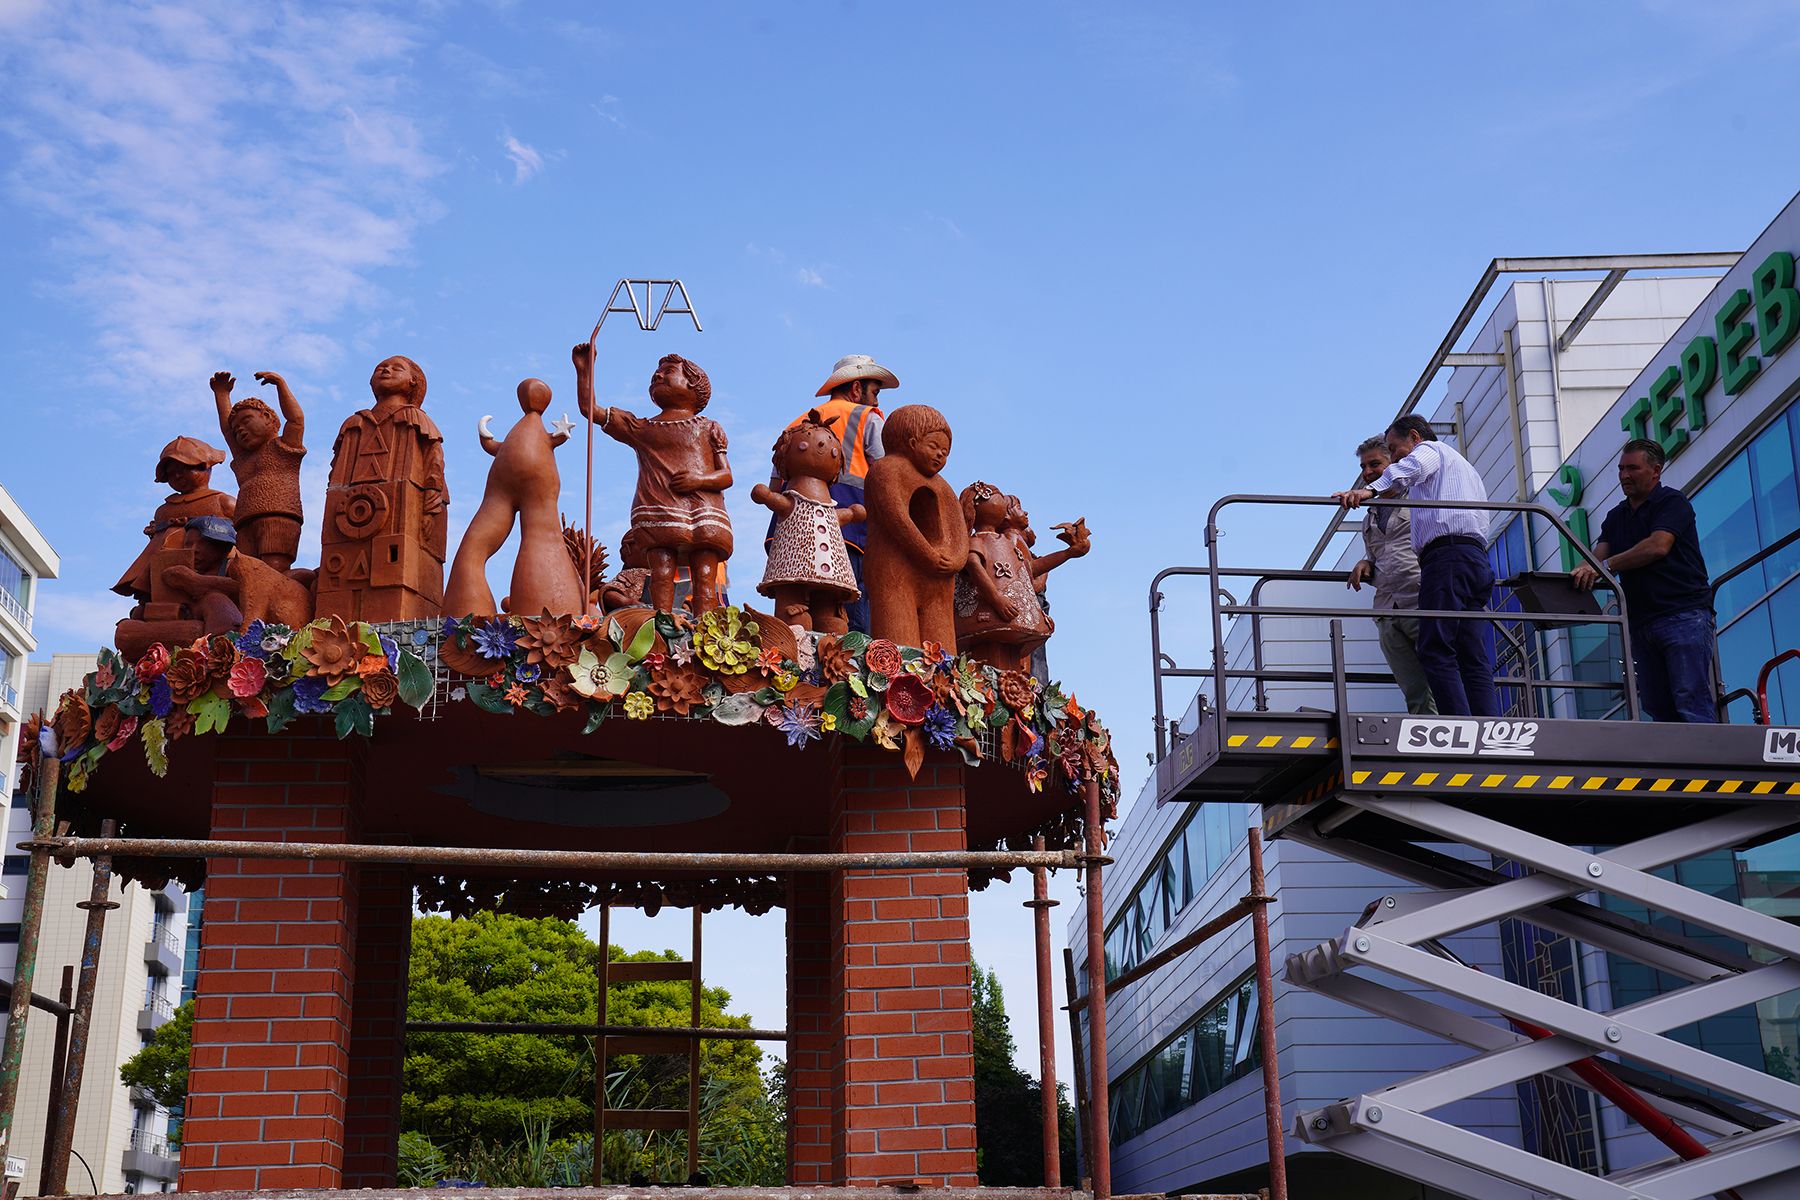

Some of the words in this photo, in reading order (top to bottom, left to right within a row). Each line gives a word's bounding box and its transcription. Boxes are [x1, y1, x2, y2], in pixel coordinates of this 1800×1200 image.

[594, 278, 703, 332] ATA
[1621, 251, 1800, 461] TEPEB
[1407, 724, 1470, 749] SCL
[1480, 721, 1539, 745] 1012
